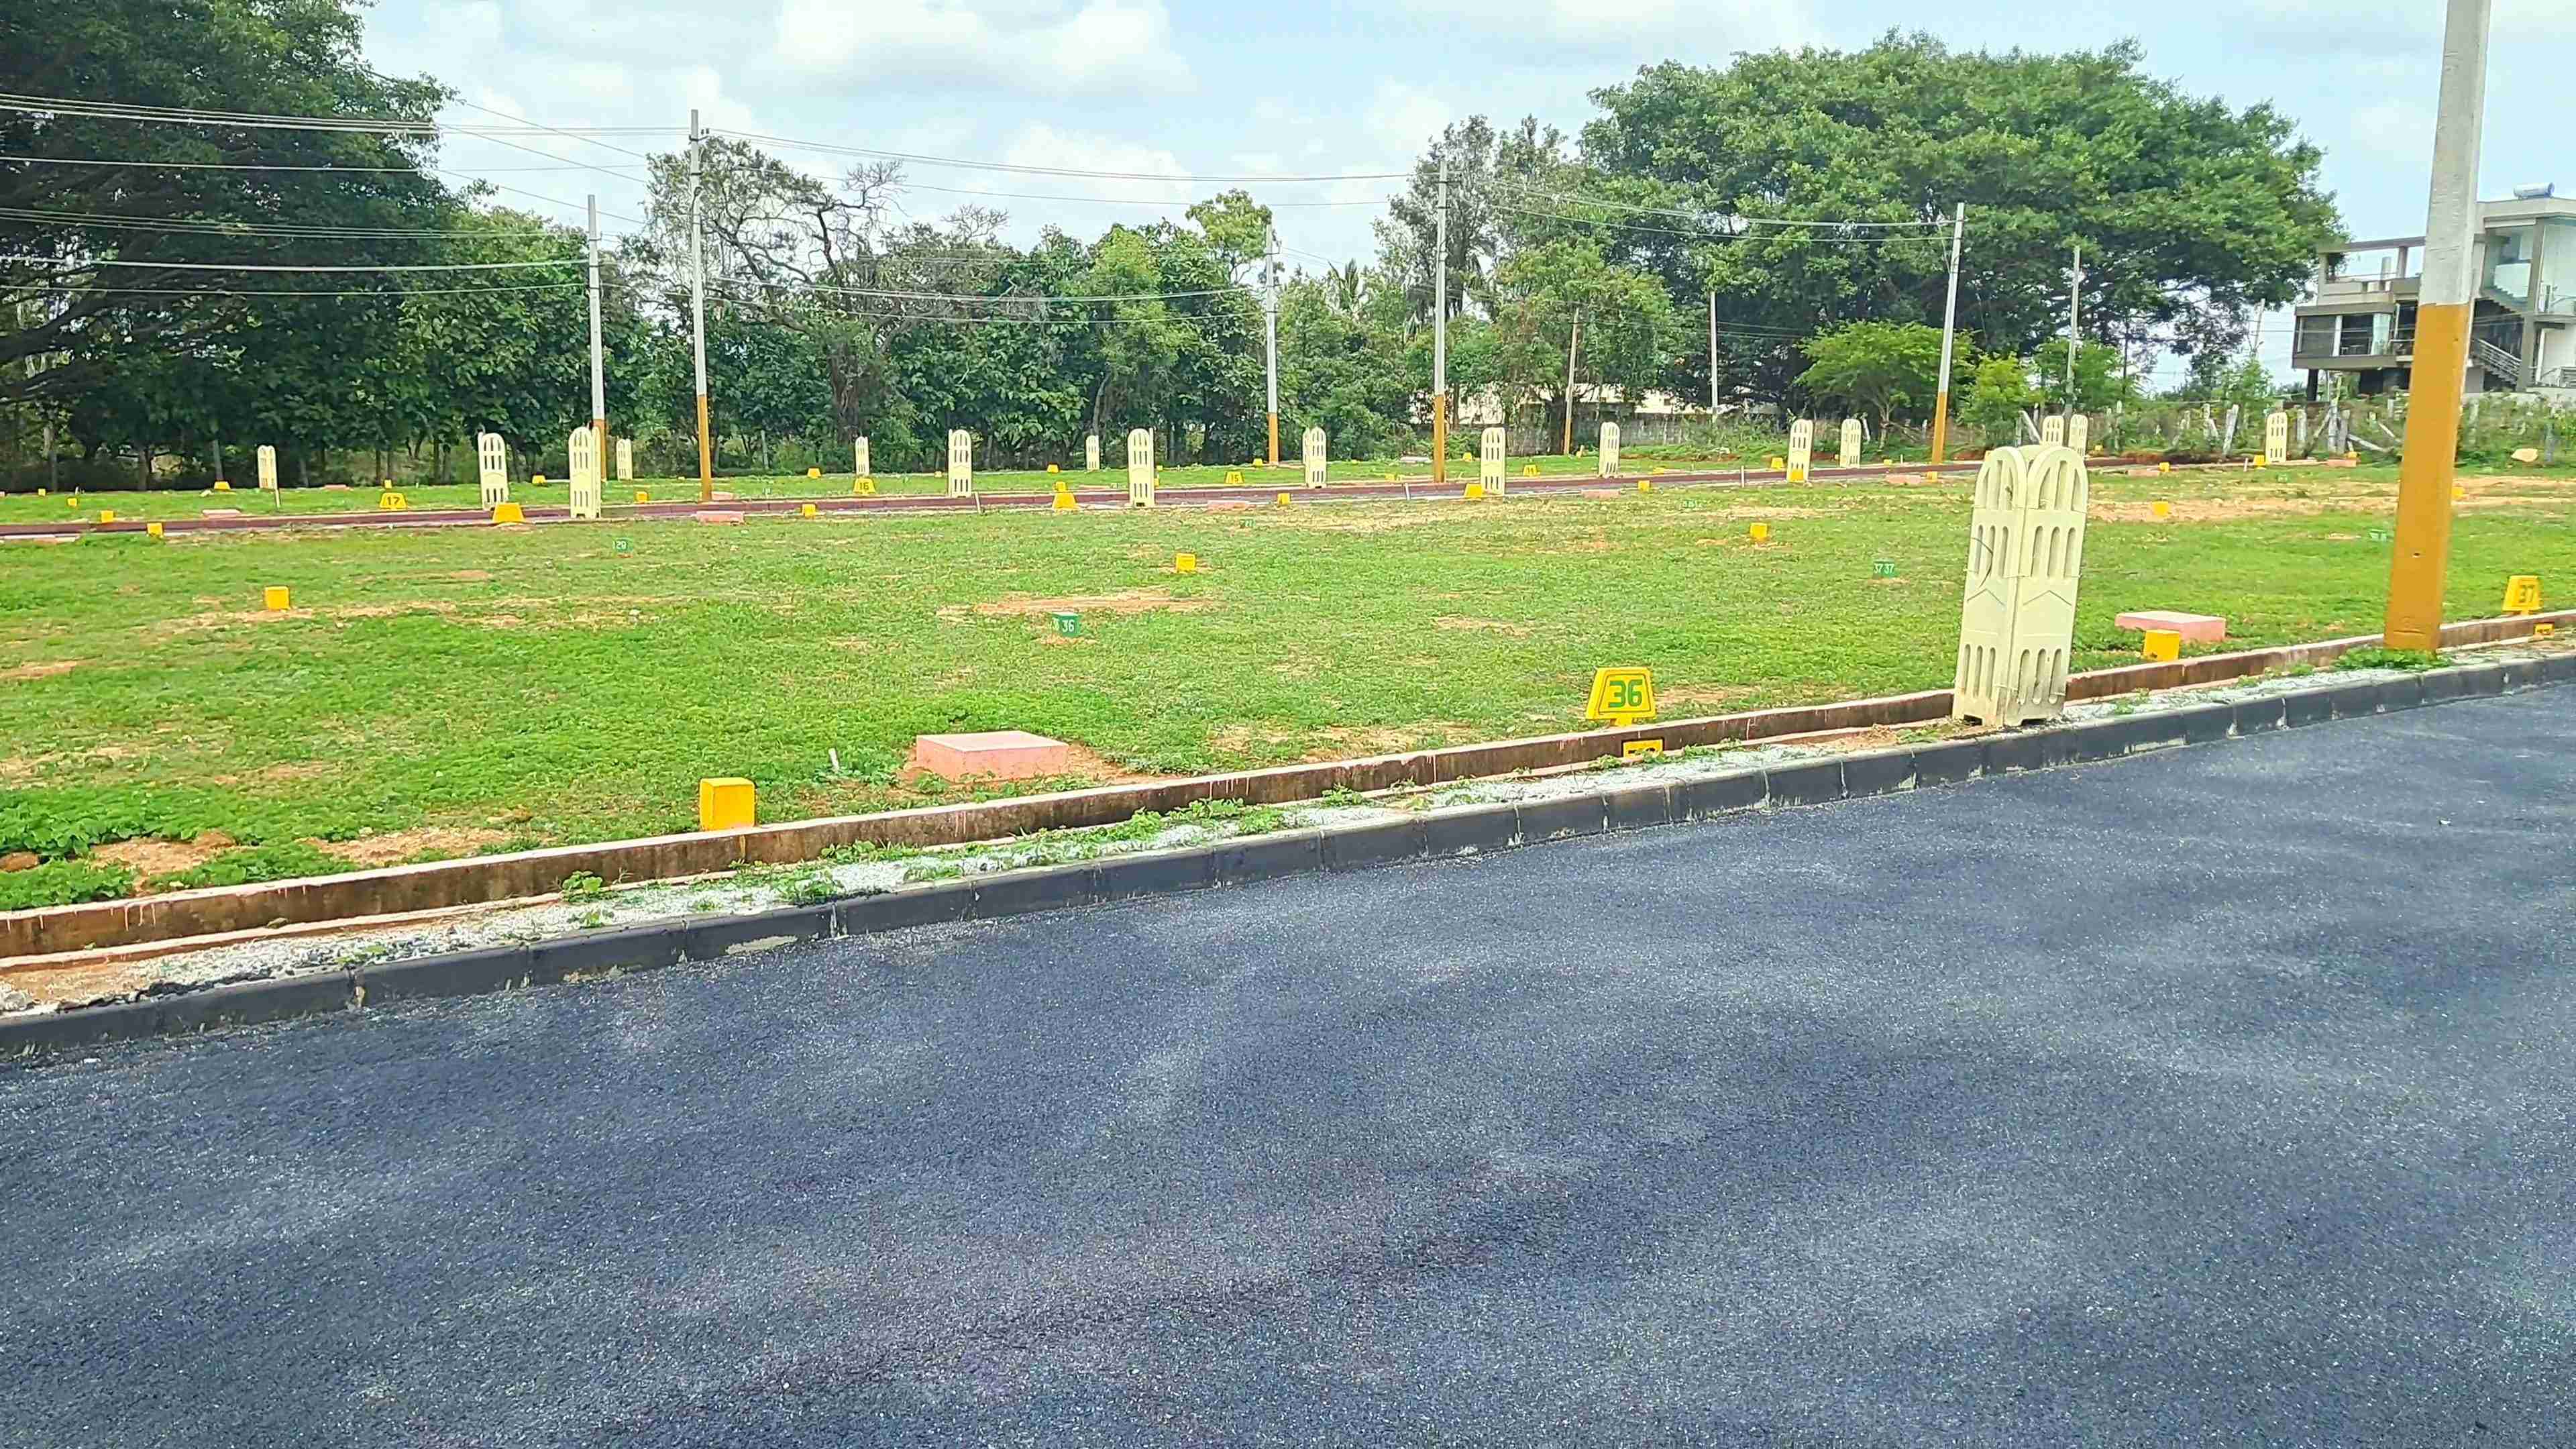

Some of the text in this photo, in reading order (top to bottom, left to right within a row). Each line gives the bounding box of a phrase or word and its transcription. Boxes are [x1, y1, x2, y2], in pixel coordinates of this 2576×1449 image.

[859, 482, 869, 490] 16
[387, 496, 400, 505] 17
[1884, 563, 1895, 575] 37
[2518, 584, 2534, 603] 37
[1062, 619, 1075, 633] 36
[1608, 679, 1643, 708] 36
